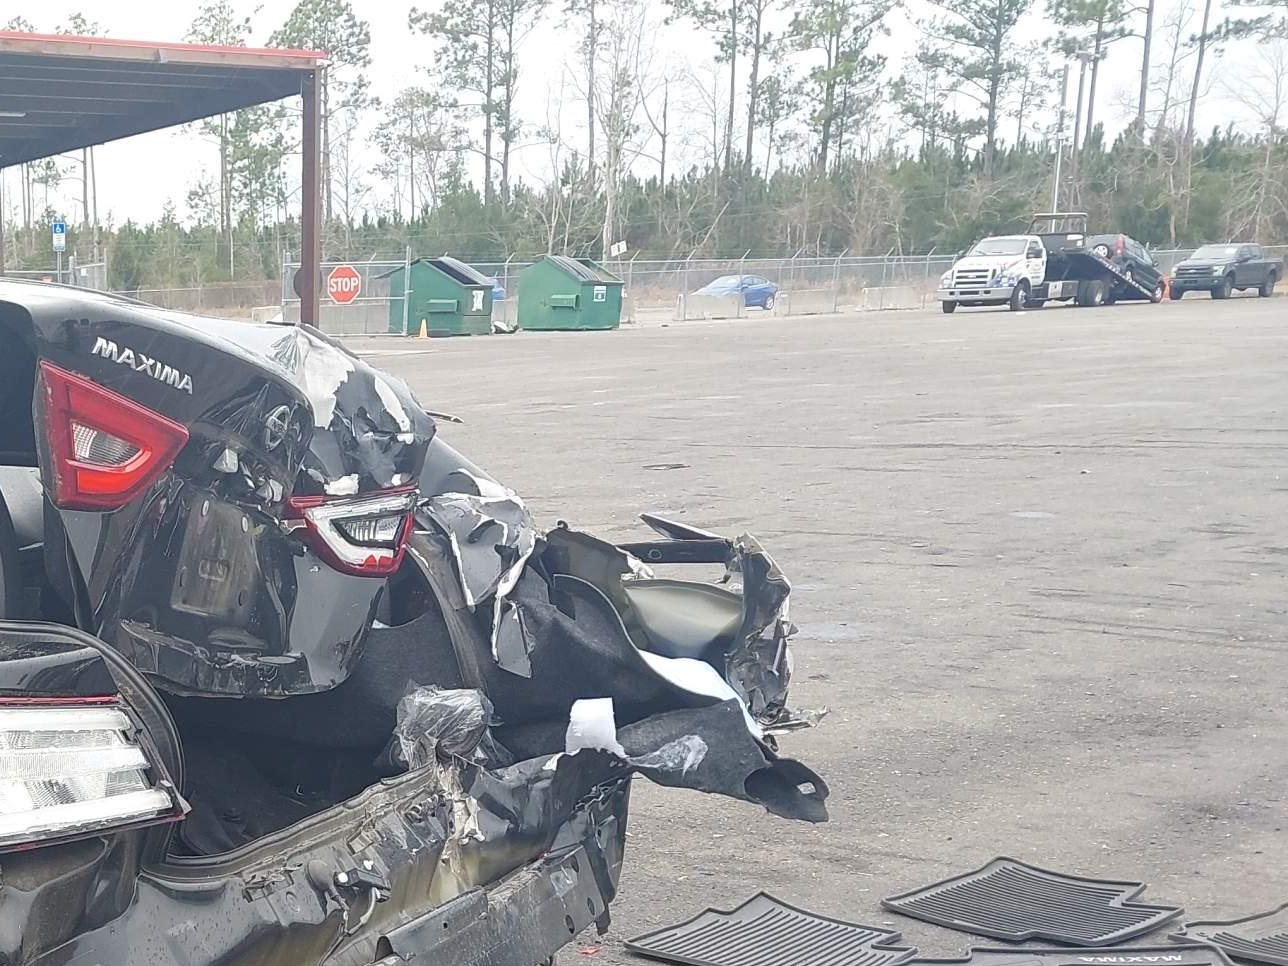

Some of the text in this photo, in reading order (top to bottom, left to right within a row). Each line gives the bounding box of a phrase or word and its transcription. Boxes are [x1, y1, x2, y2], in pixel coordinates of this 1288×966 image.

[329, 277, 359, 292] STOP
[92, 336, 193, 394] MAXIMA
[1078, 954, 1182, 963] MAXIMA
